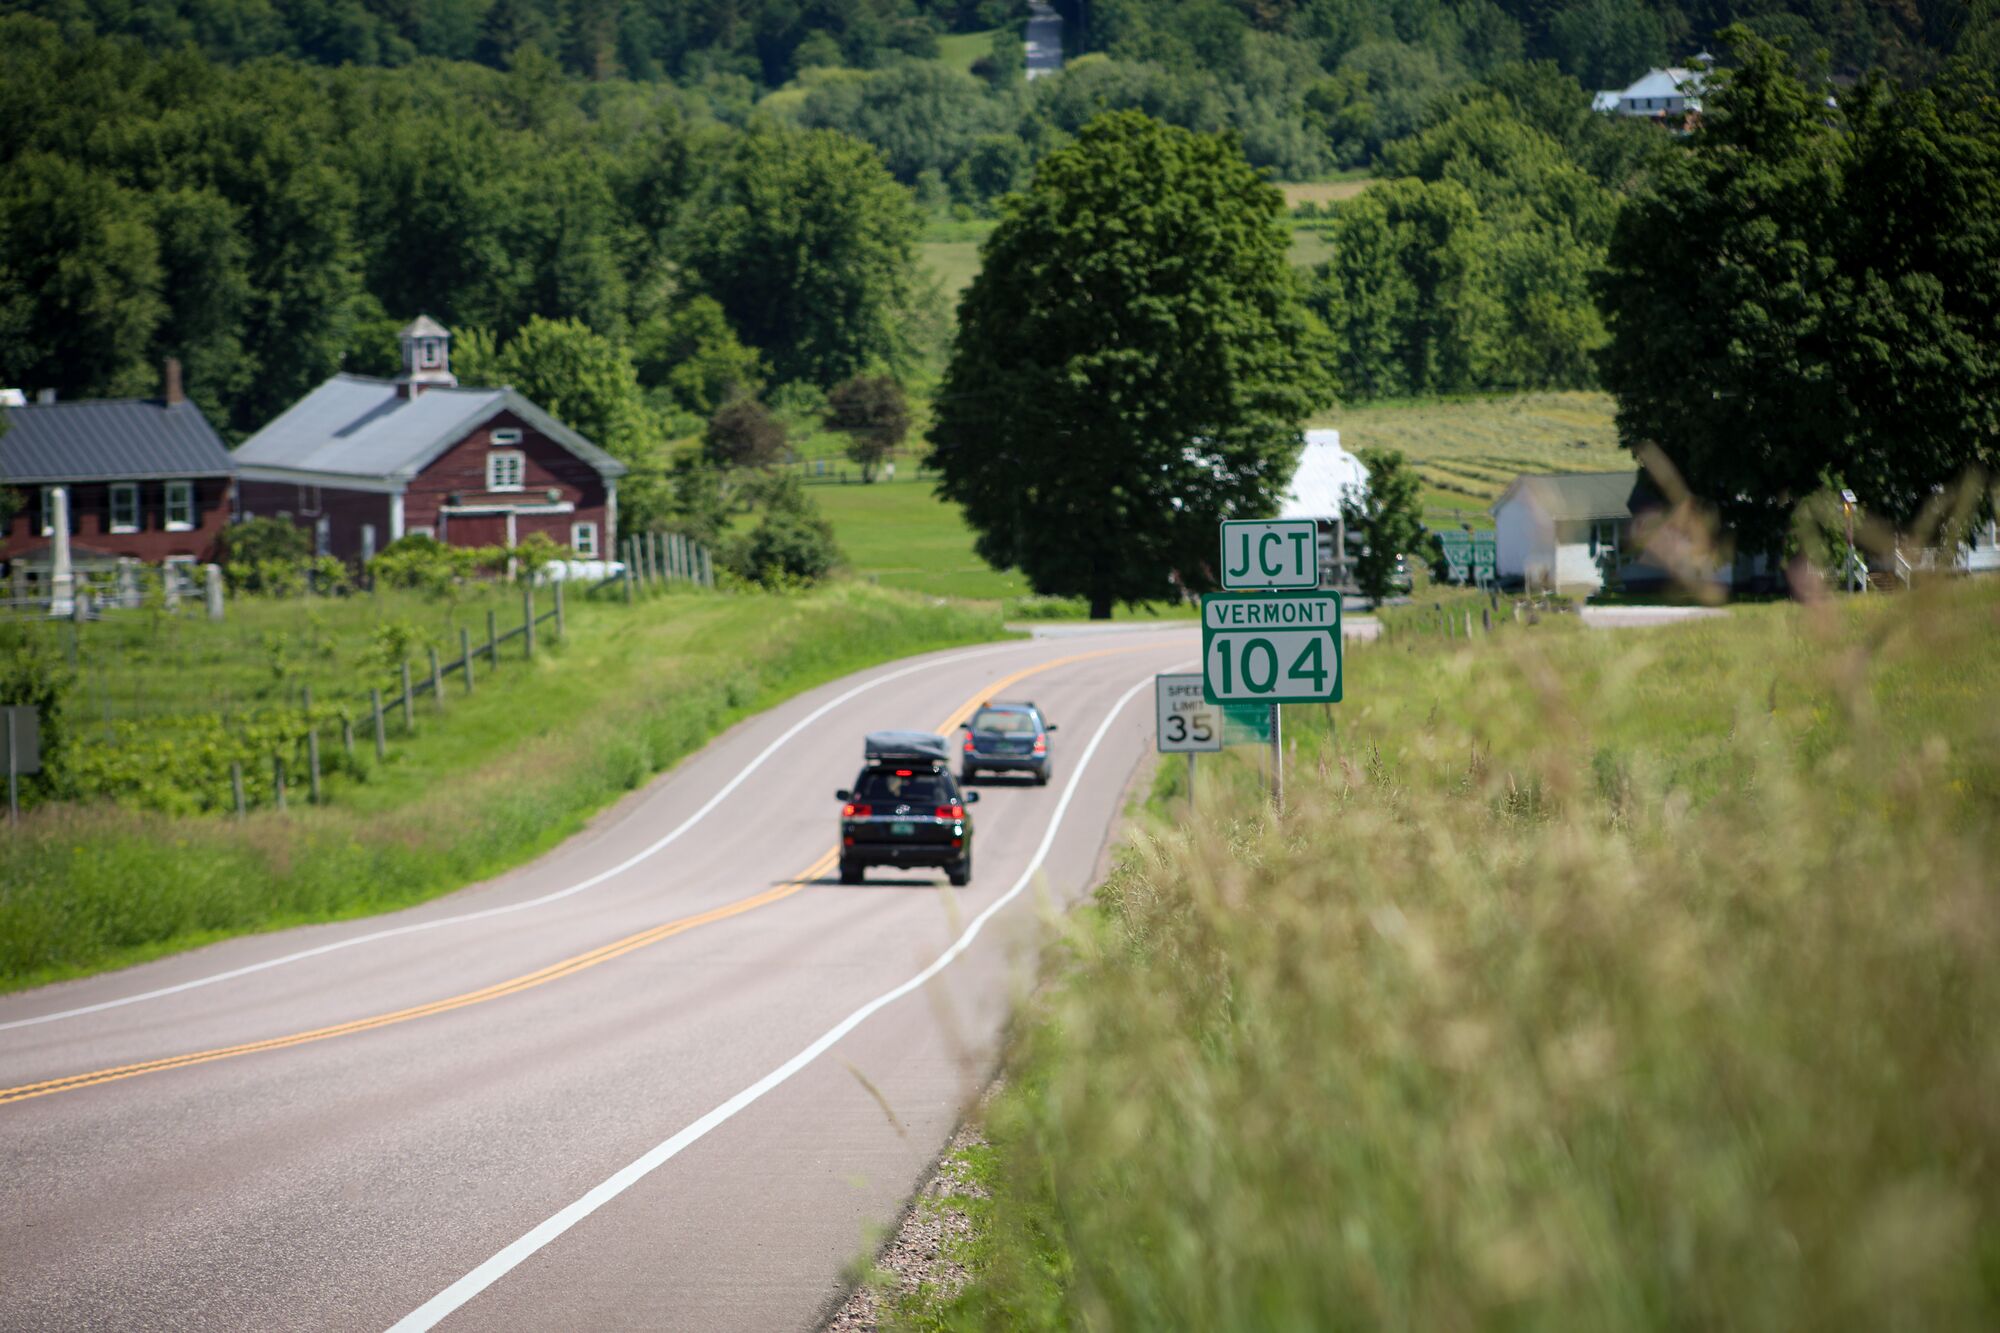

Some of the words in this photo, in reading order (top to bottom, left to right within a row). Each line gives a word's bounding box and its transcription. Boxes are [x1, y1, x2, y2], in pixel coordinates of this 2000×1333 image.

[1229, 532, 1310, 577] JCT
[1215, 602, 1328, 624] VERMONT
[1217, 637, 1328, 694] 104
[1168, 685, 1204, 697] SPEE
[1172, 700, 1204, 713] LIMIT
[1167, 715, 1213, 743] 35
